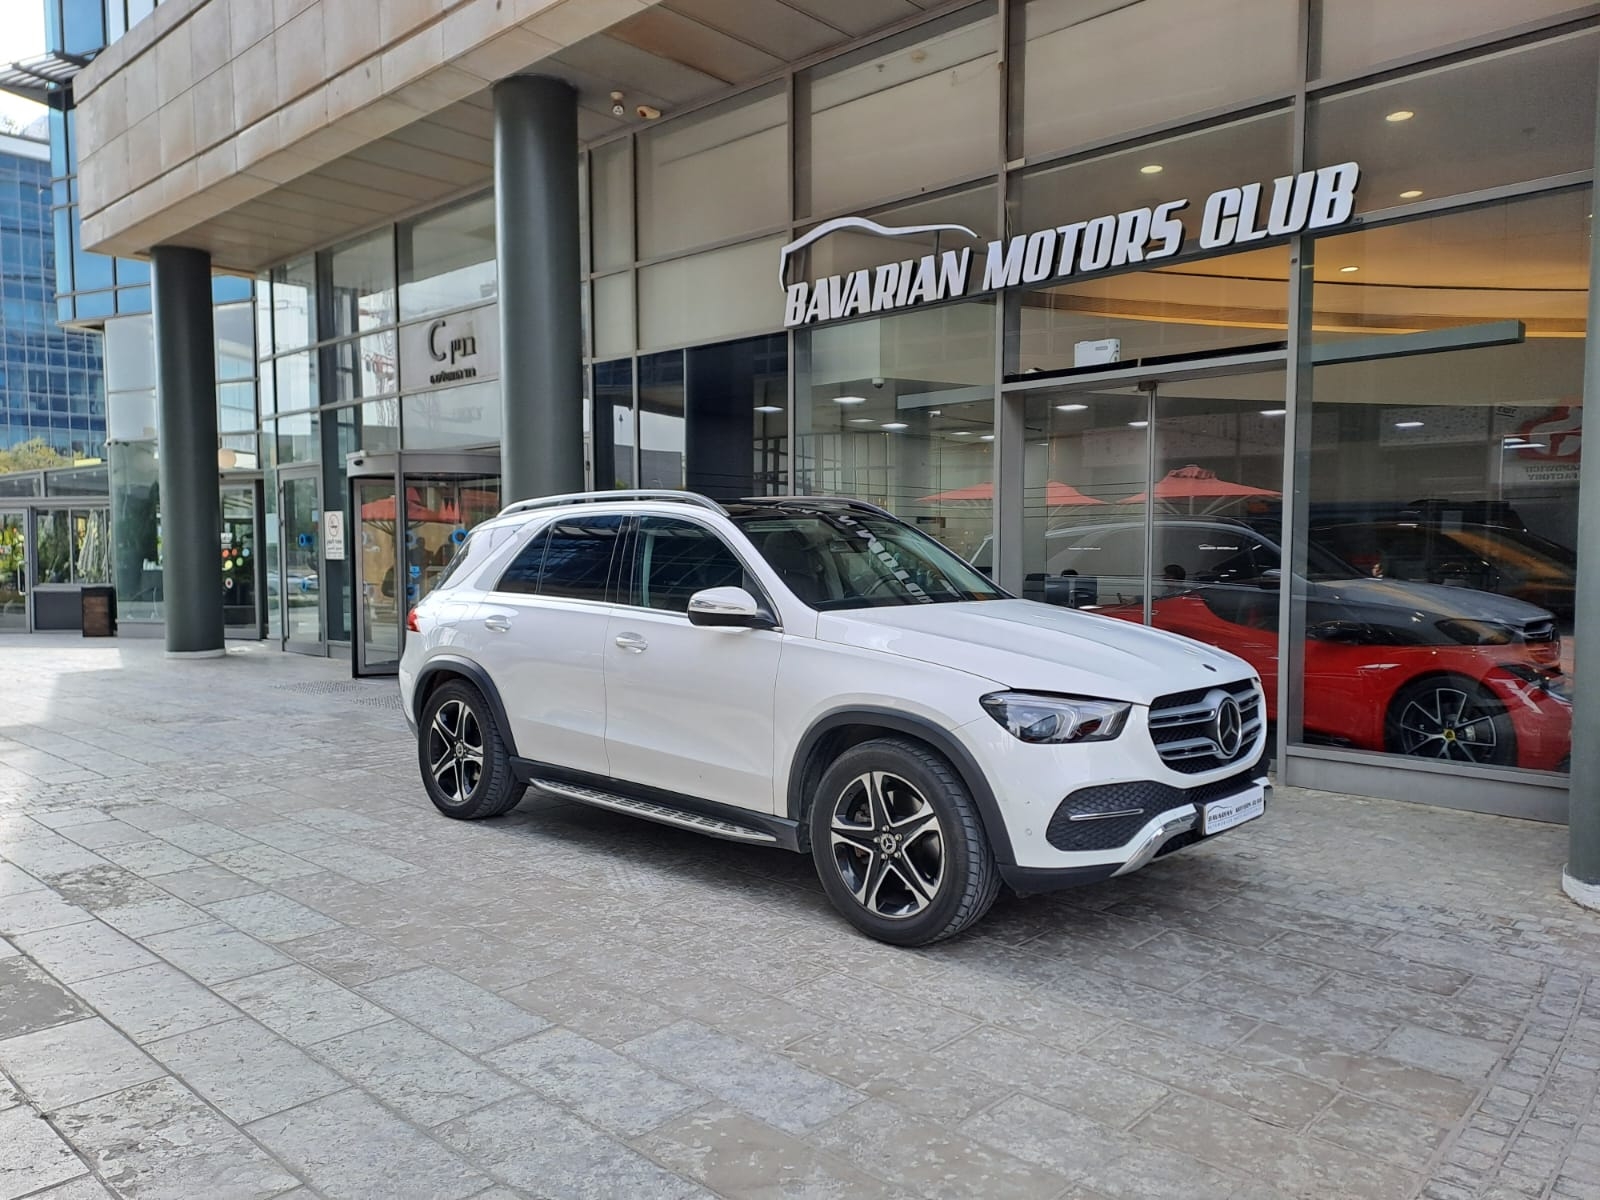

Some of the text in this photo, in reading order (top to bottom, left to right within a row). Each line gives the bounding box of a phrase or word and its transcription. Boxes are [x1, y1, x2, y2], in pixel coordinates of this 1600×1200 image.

[784, 161, 1360, 327] BAVARIAN MOTORS CLUB
[428, 319, 447, 362] C
